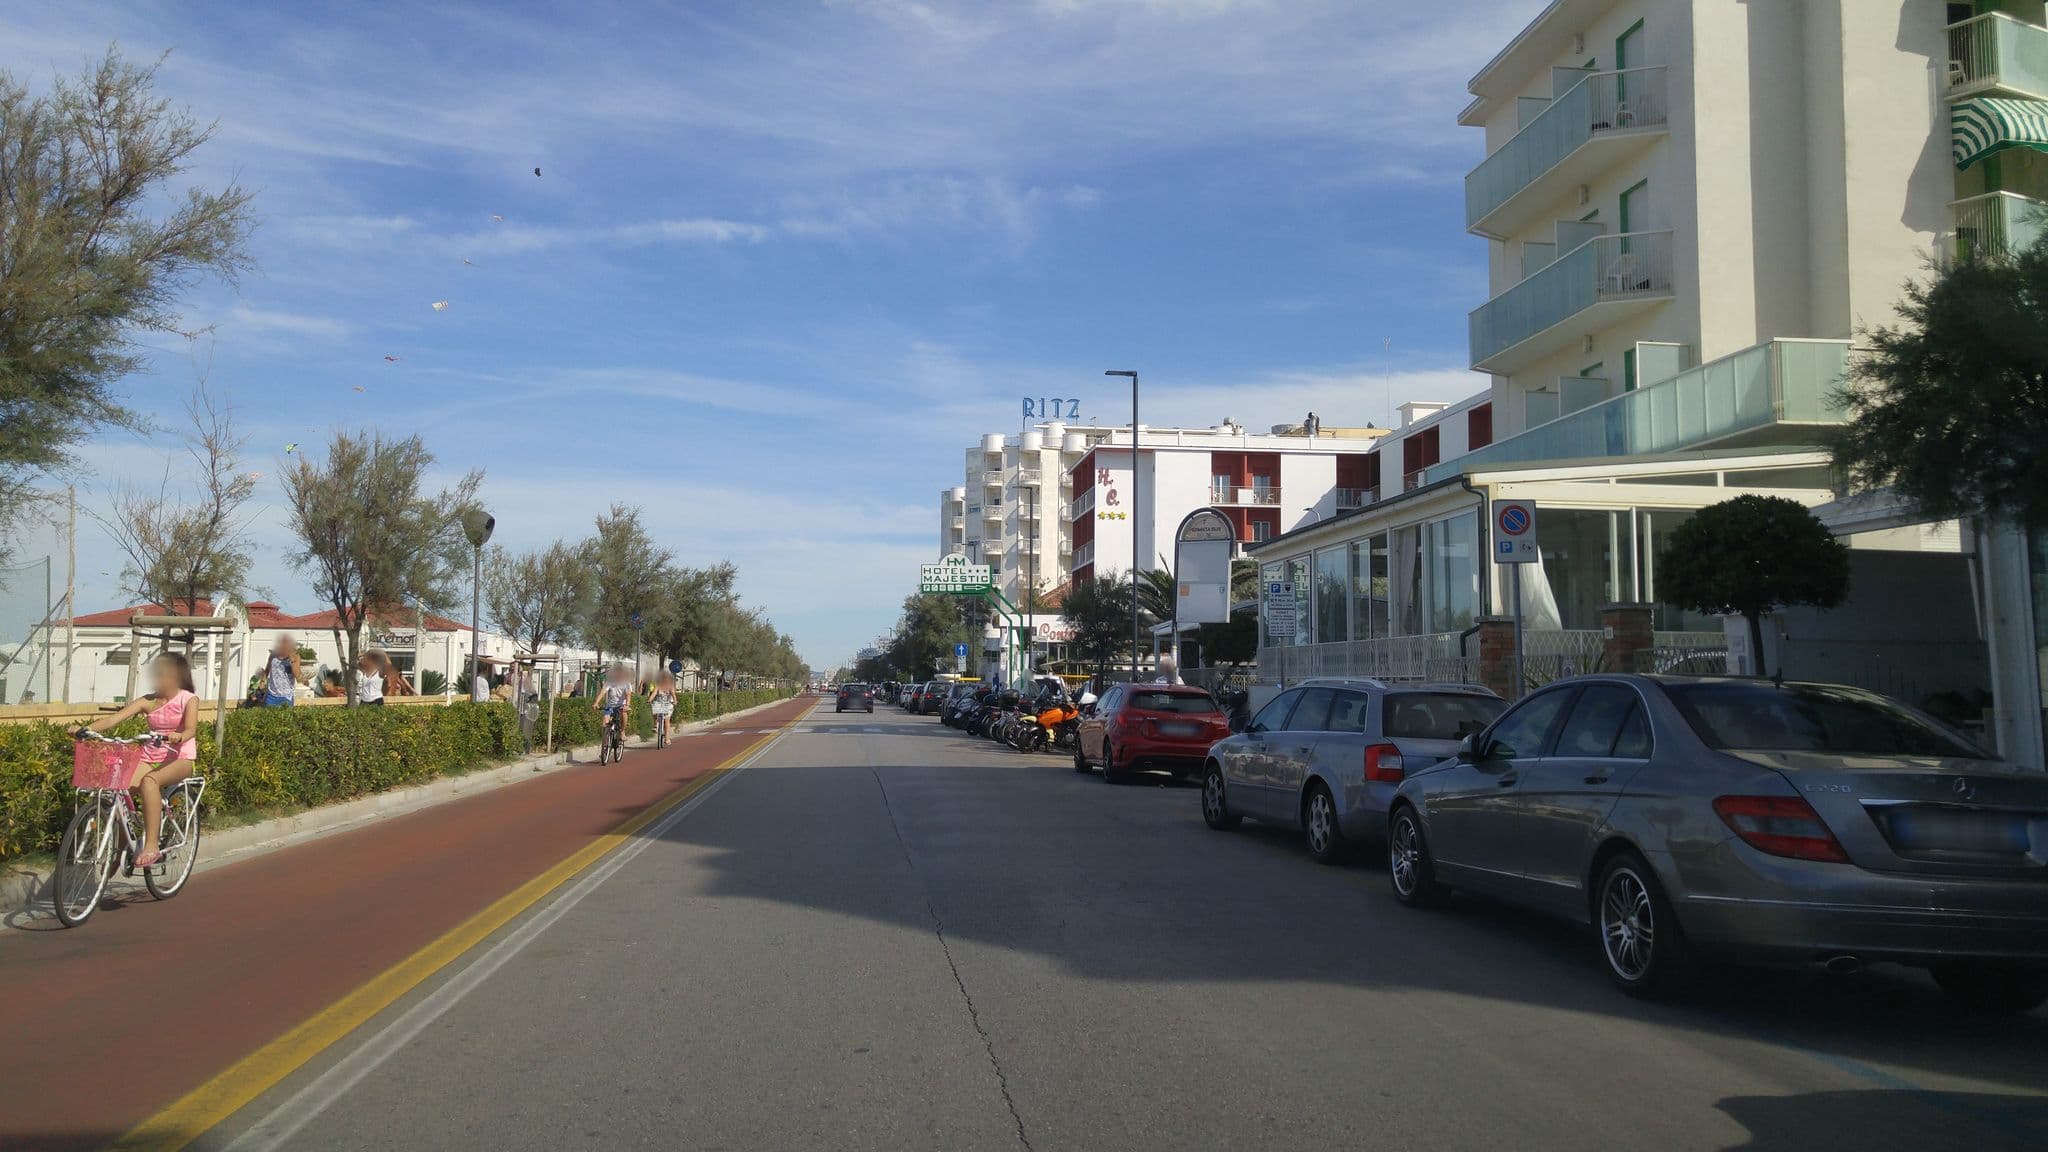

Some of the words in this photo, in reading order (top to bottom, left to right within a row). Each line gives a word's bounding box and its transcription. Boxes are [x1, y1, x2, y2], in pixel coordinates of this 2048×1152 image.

[1022, 397, 1080, 418] RITZ
[946, 557, 966, 567] HM
[923, 567, 966, 575] HOTEL
[923, 575, 989, 583] MAJESTIC
